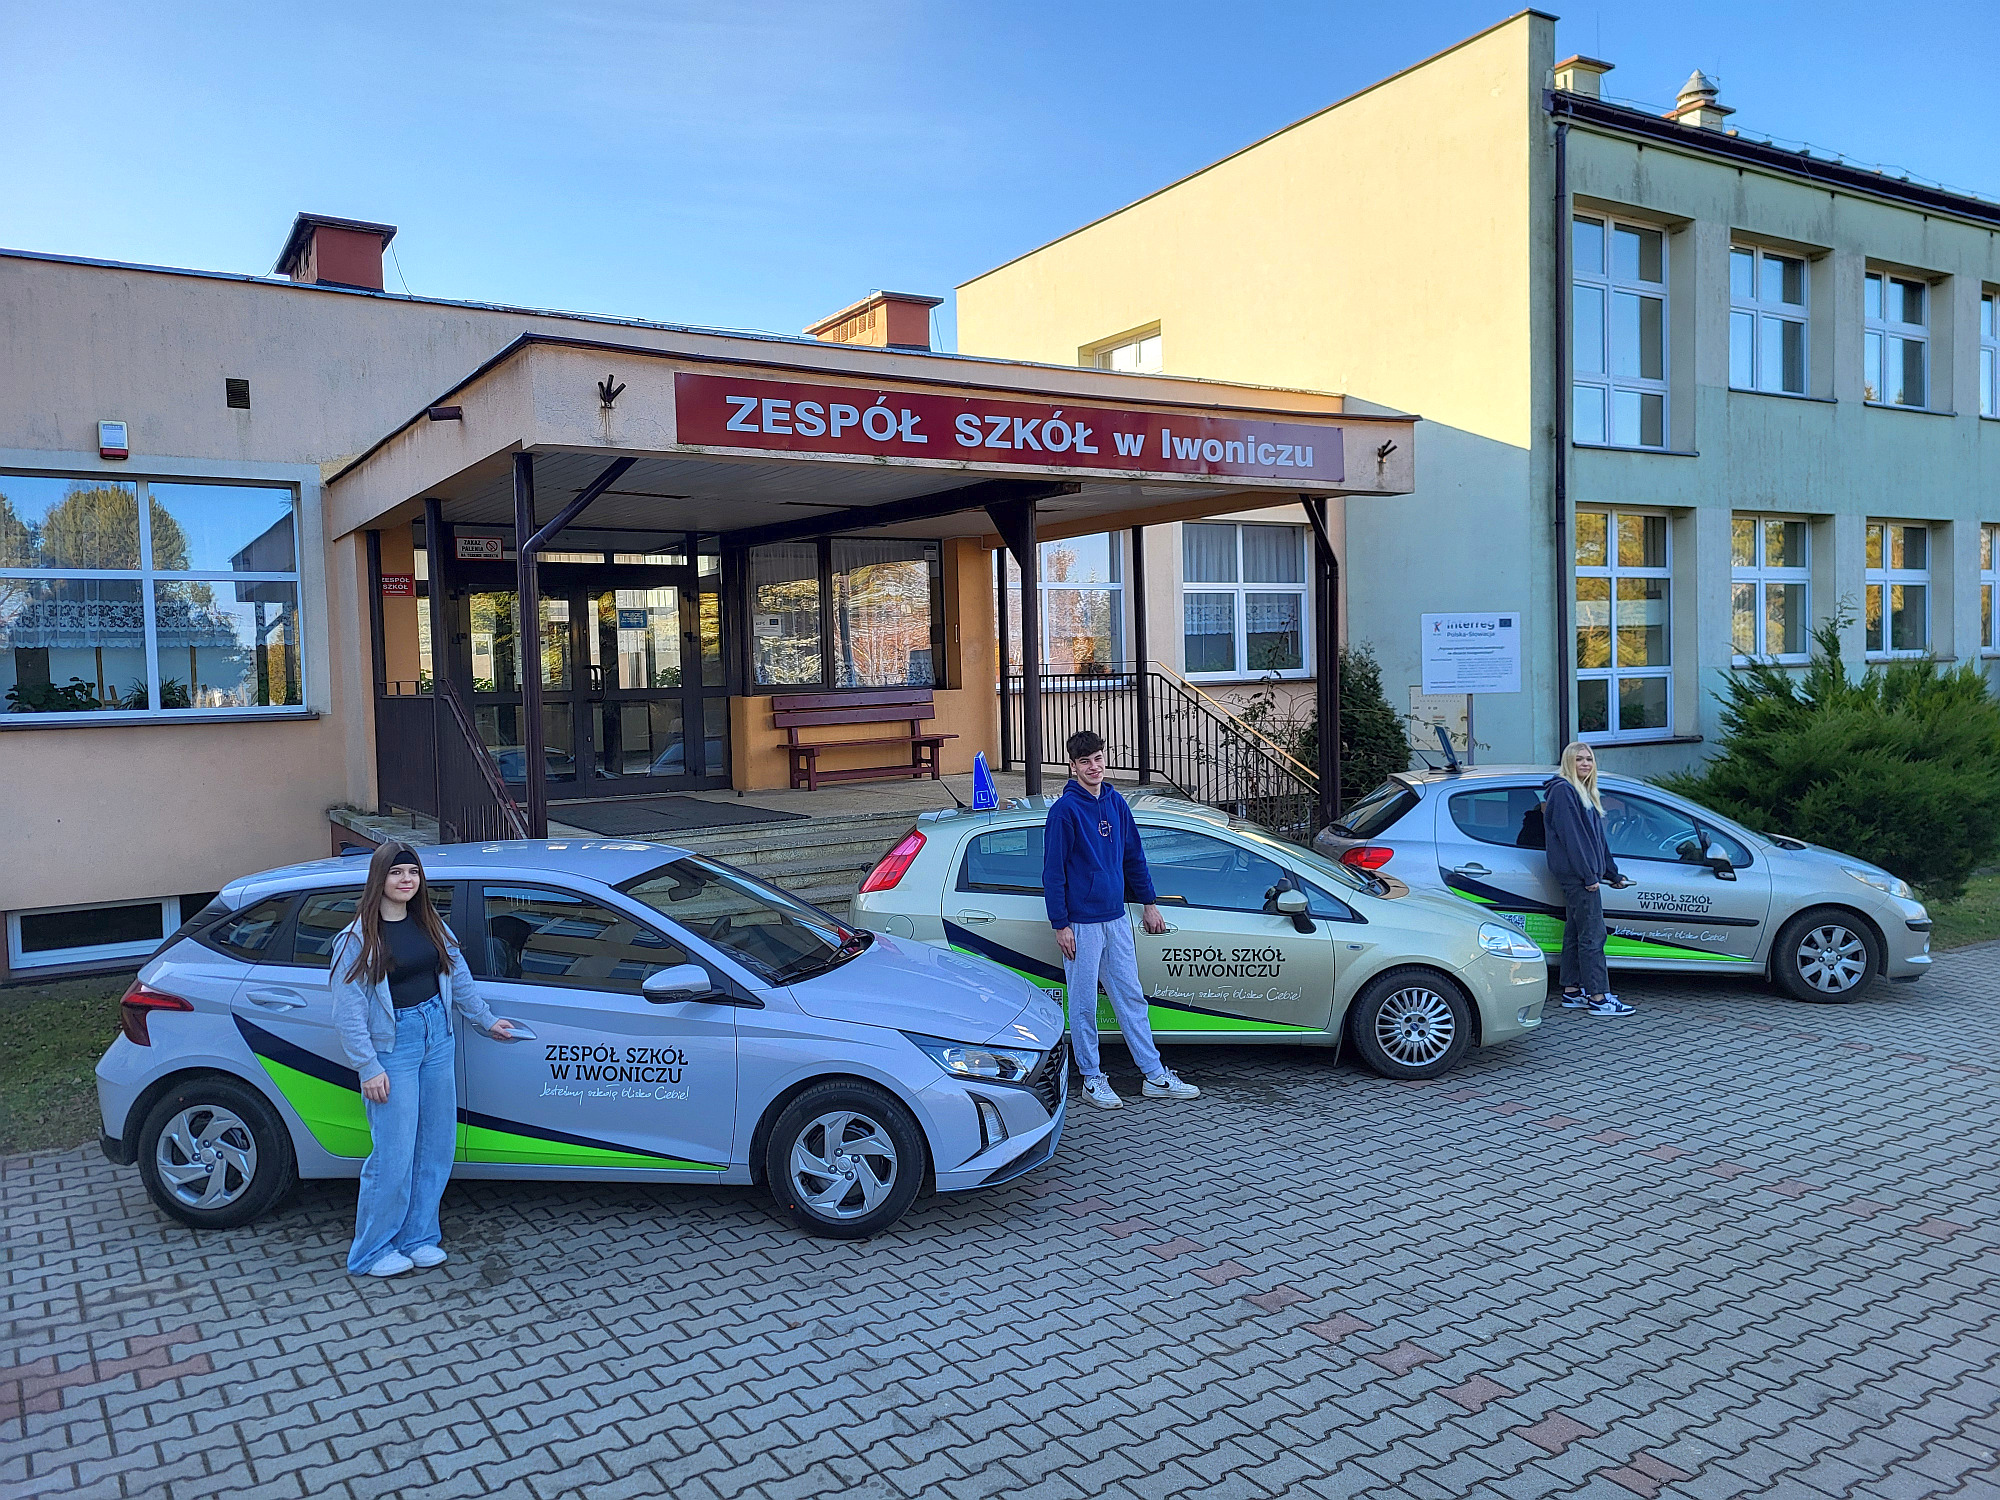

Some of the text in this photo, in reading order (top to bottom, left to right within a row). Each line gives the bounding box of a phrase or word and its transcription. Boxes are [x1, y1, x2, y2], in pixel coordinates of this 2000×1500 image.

[725, 394, 1314, 468] ZESPÓŁ SZKÓŁ w Iwoniczu
[980, 793, 987, 801] L
[1636, 891, 1713, 905] ZESPÓŁ SZKÓŁ
[1639, 901, 1710, 914] W IWONICZU
[1161, 945, 1286, 962] ZESPÓŁ SZKÓŁ
[1166, 963, 1281, 978] W IWONICZU
[1266, 986, 1302, 1001] Ciebie!
[544, 1042, 689, 1066] ZESPÓŁ SZKÓŁ
[550, 1064, 683, 1084] W IWONICZU
[654, 1085, 690, 1101] Ciebie!
